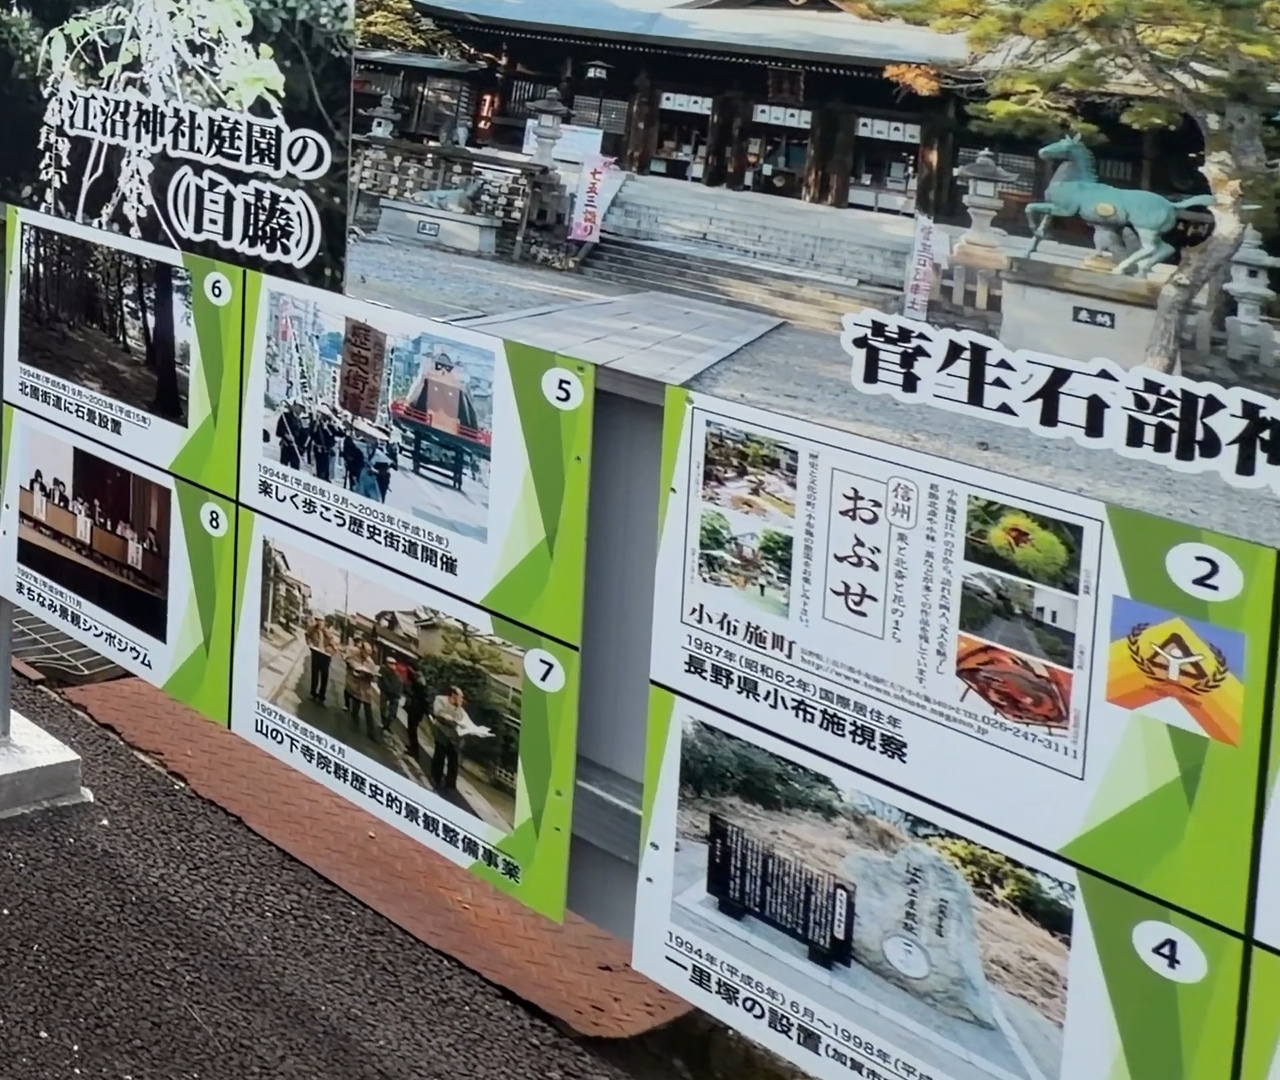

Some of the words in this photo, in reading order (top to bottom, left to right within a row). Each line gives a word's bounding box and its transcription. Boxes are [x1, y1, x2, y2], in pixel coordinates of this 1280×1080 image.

[67, 92, 325, 173] 江沼神社庭園の
[212, 280, 222, 298] 6
[555, 379, 572, 402] 5
[257, 463, 330, 502] 1994年(平成6年)
[891, 482, 914, 524] 信州
[209, 510, 220, 530] 8
[258, 479, 459, 576] 楽しく歩こう歴史街道開催
[830, 487, 883, 618] おぶせ
[1192, 555, 1220, 591] 2
[890, 531, 908, 644] 栗と北斎と花のまち
[15, 580, 153, 670] まちなみ景観シンポジウム
[690, 603, 796, 660] 小布施町
[538, 658, 555, 682] 7
[685, 634, 903, 730] 1987年(昭和62年)国際居住年
[255, 700, 328, 751] 1997年(平成9年)
[330, 742, 346, 759] 4月
[684, 653, 908, 764] 長野県小布施視察
[981, 710, 1079, 760] 026-247-3111
[254, 718, 520, 885] 山の下寺院群歴史的景観整備事業
[667, 930, 786, 1007] 1994年(平成6年)
[1150, 937, 1181, 970] 4
[664, 955, 893, 1080] 一里塚の設置(加賀市
